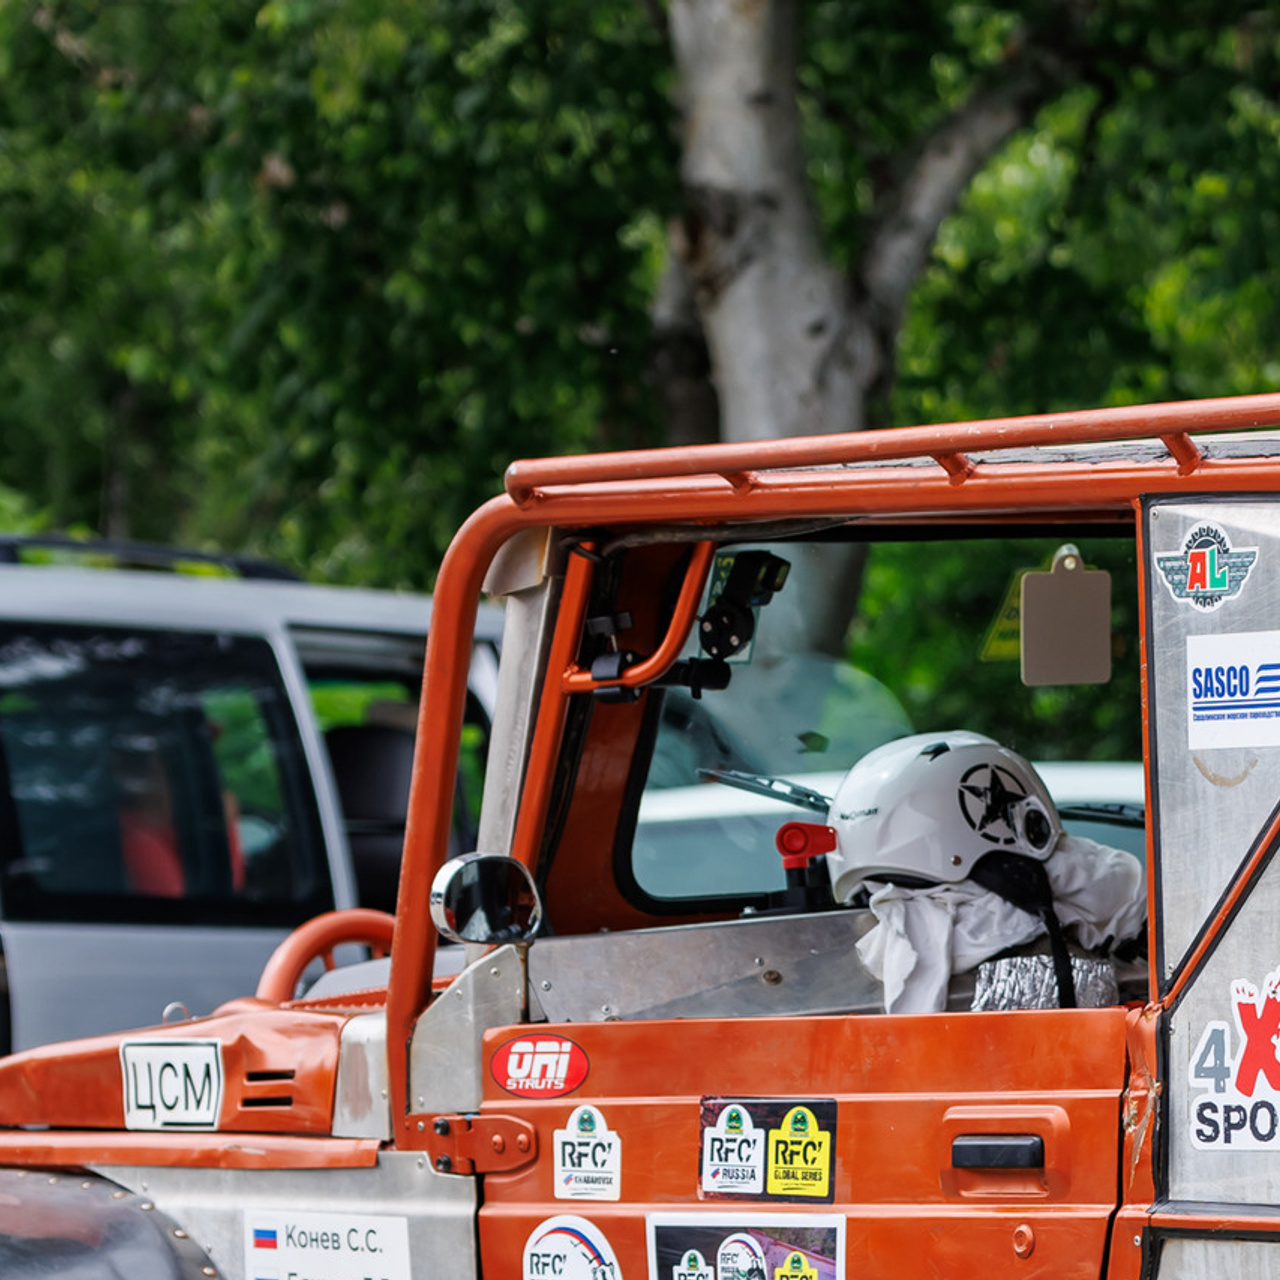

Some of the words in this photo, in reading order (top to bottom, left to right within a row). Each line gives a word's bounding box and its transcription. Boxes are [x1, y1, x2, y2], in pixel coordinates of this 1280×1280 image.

[1192, 664, 1250, 699] SASCO
[132, 1062, 213, 1123] ЦСМ
[506, 1078, 566, 1091] STRUTS
[721, 1168, 757, 1181] RUSSIA
[774, 1169, 799, 1181] GLOBAL
[801, 1171, 823, 1182] SERIES
[285, 1224, 341, 1251] Конев
[347, 1228, 384, 1254] С.С.
